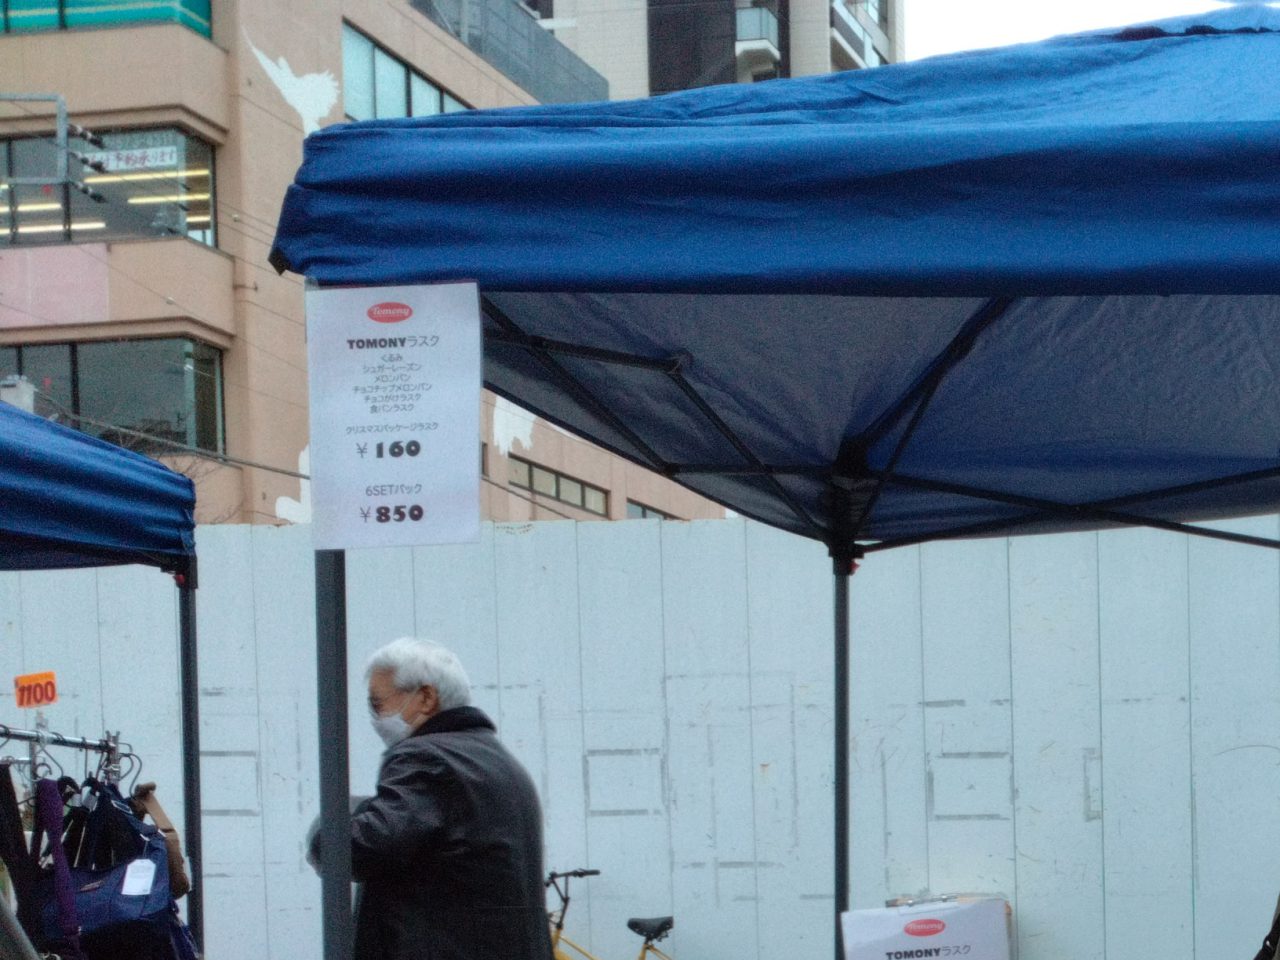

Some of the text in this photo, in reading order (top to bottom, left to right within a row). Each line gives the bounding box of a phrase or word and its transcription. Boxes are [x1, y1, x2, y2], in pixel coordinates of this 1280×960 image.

[370, 305, 410, 317] Tomony
[380, 353, 404, 362] くるみ
[362, 363, 423, 374] シュガーレーズン
[374, 373, 412, 383] メロンパン
[352, 382, 432, 394] チョコチップメロンパン
[369, 403, 415, 414] 食パンラスク
[365, 483, 423, 497] 6SETパック
[909, 922, 946, 932] Tomony
